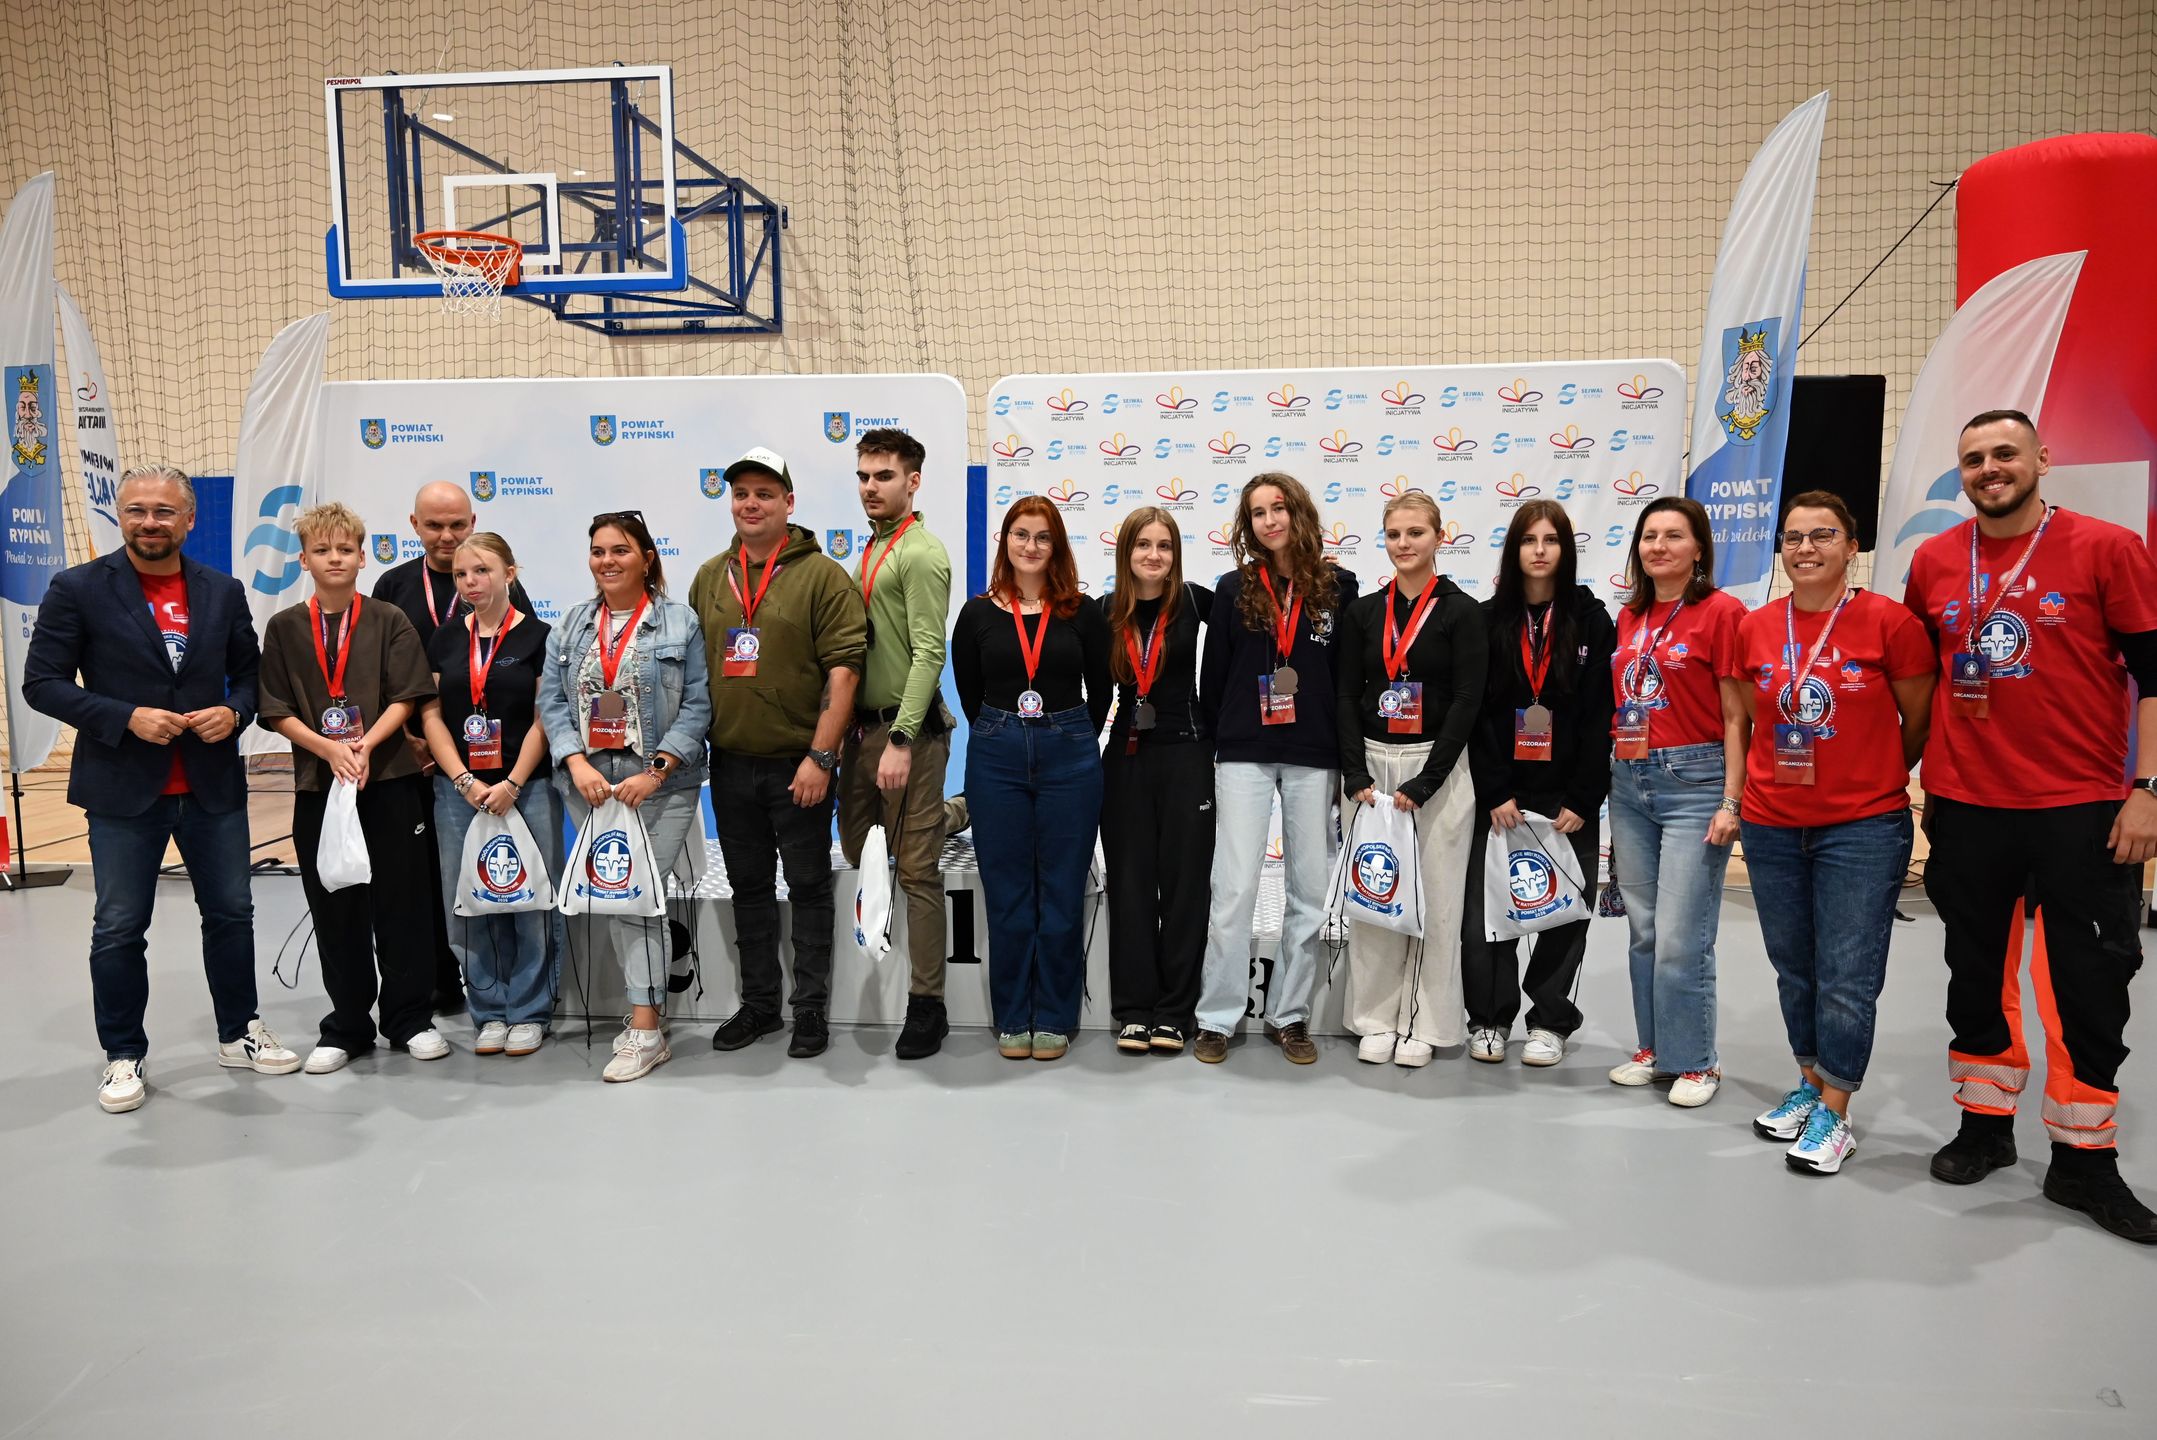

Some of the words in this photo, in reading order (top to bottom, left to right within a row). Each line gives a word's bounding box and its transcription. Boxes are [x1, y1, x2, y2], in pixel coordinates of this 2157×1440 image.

[621, 420, 664, 429] POWIAT
[855, 417, 899, 425] POWIAT
[391, 424, 433, 432] POWIAT
[392, 432, 444, 443] RYPIŃSKI
[622, 429, 675, 439] RYPIŃSKI
[500, 477, 543, 485] POWIAT
[501, 485, 553, 496] RYPIŃSKI
[945, 889, 981, 964] 1
